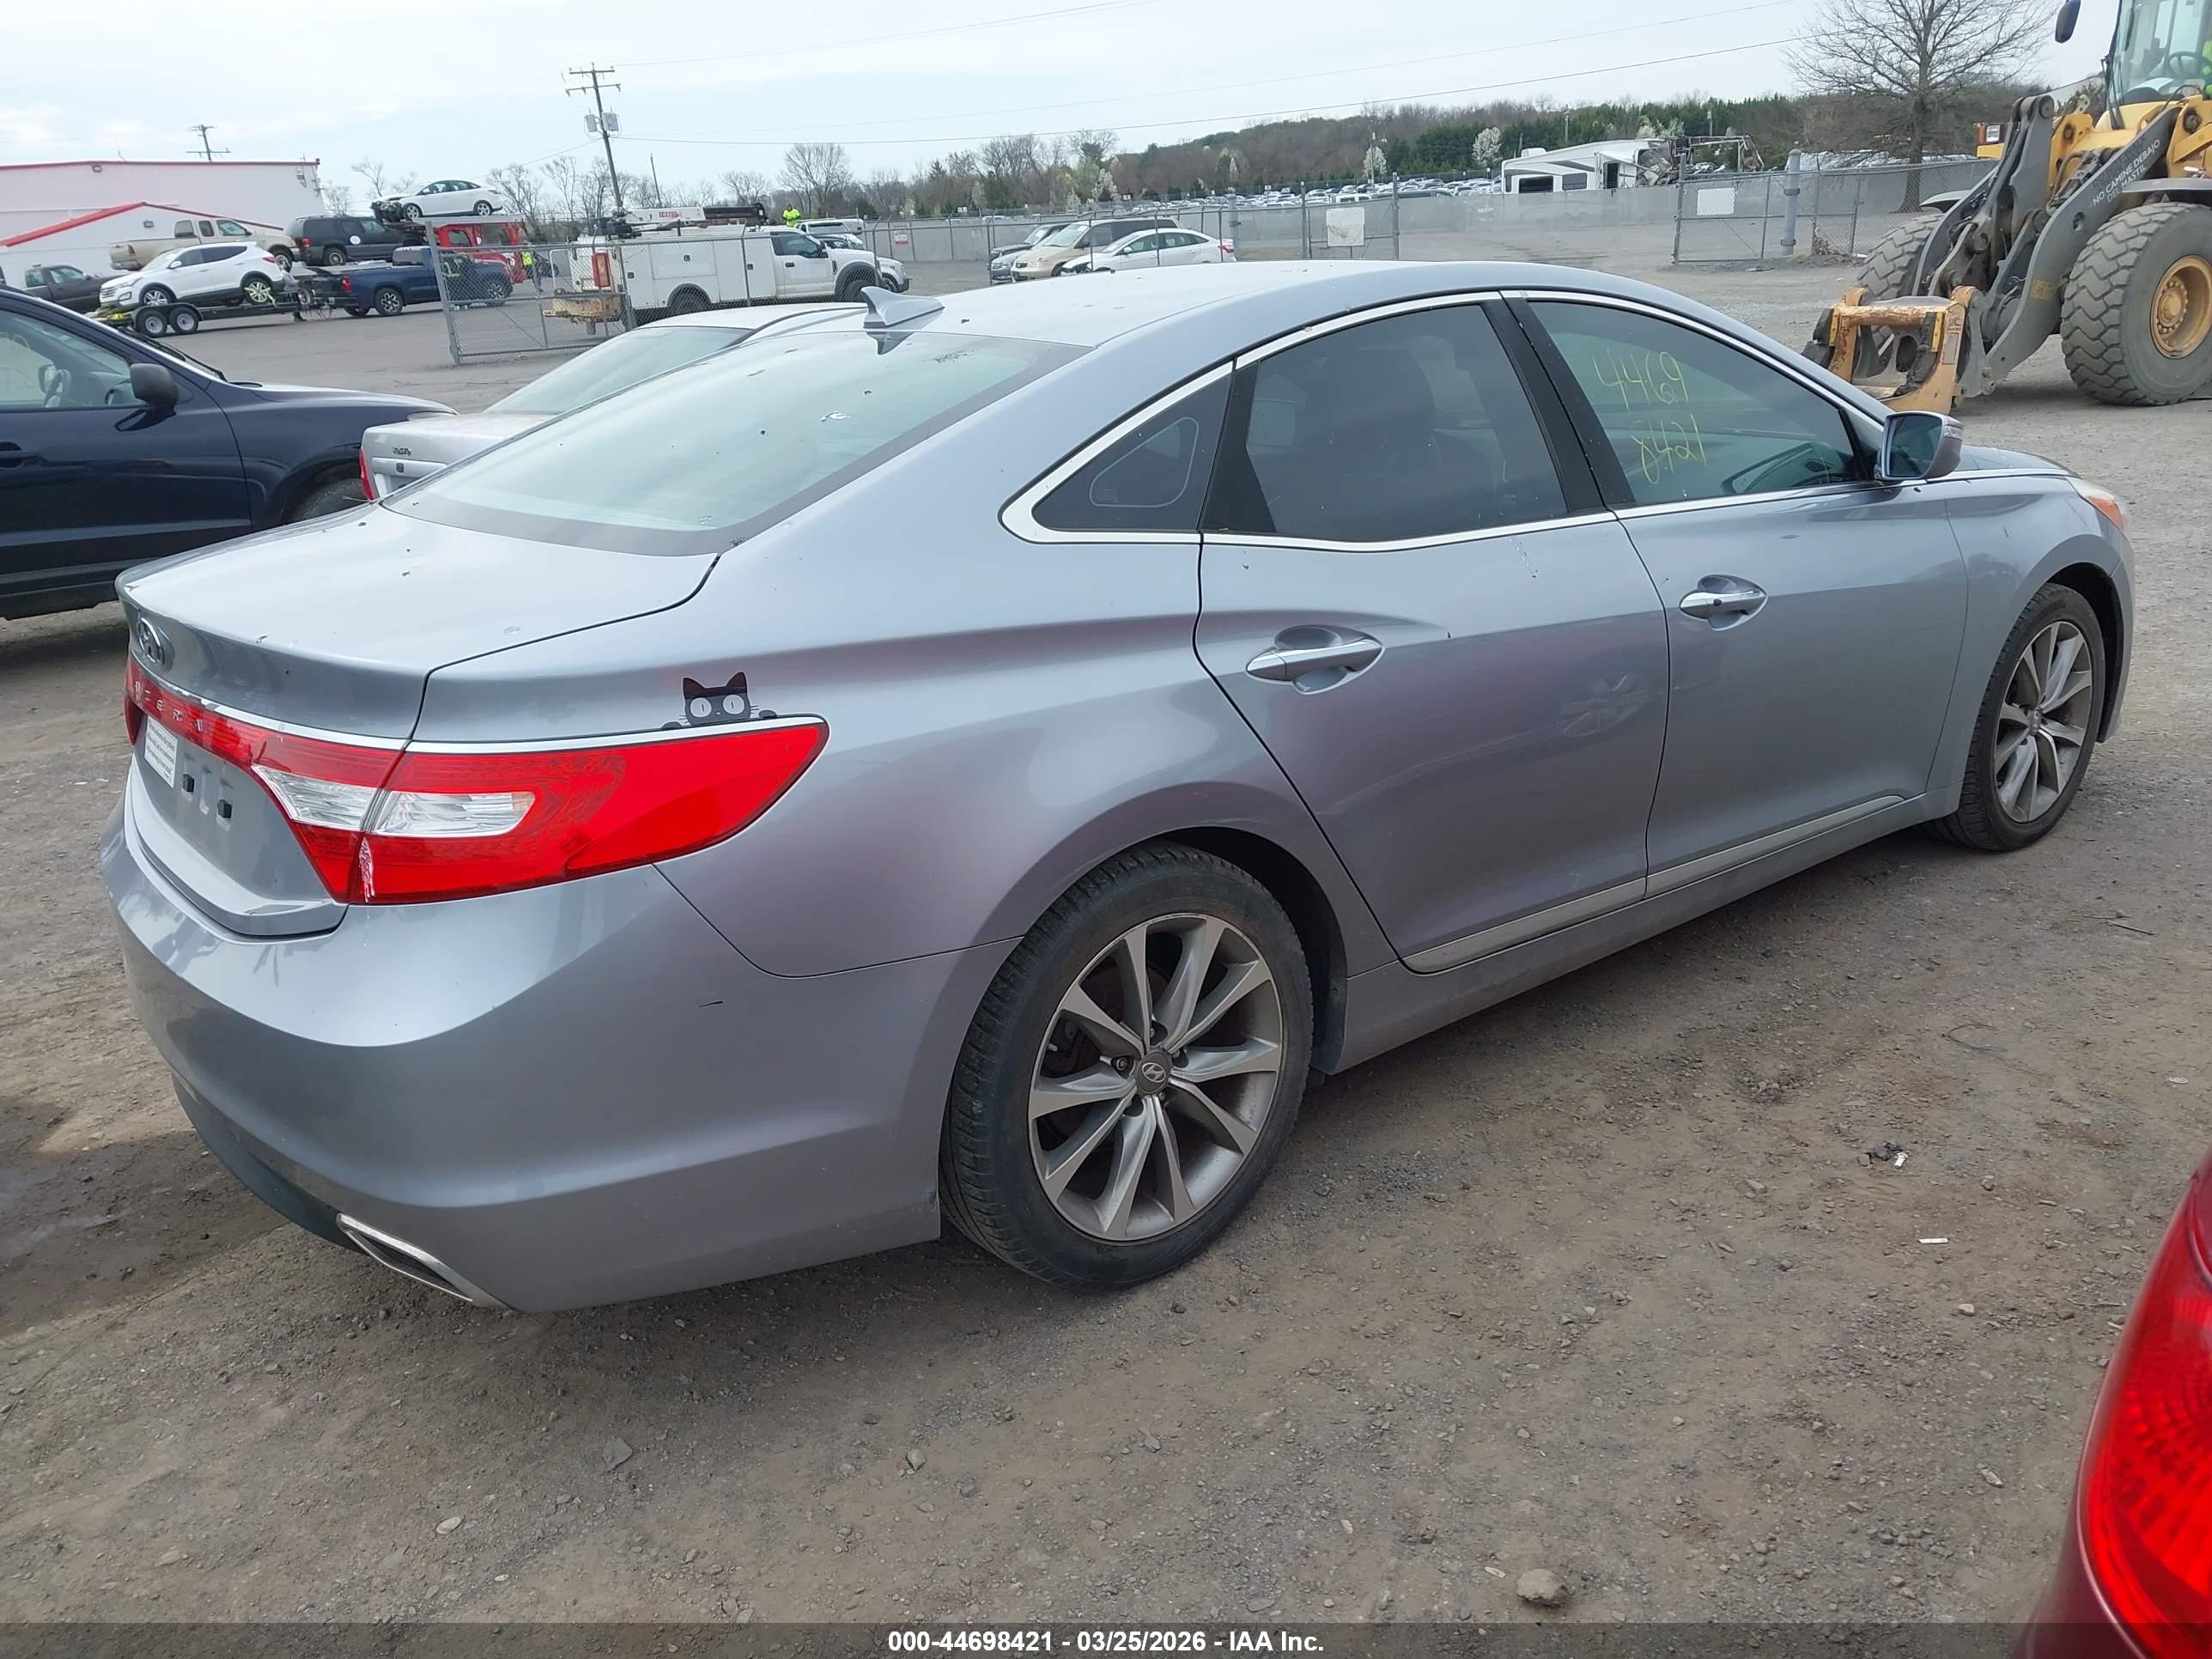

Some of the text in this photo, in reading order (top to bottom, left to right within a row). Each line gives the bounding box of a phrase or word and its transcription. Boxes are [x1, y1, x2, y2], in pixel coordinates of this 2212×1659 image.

[2093, 139, 2160, 206] NO CAMINE DEBAJO
[2107, 164, 2147, 203] DEL MASTIL
[1592, 348, 1689, 411] 4469
[1631, 413, 1707, 484] 8421
